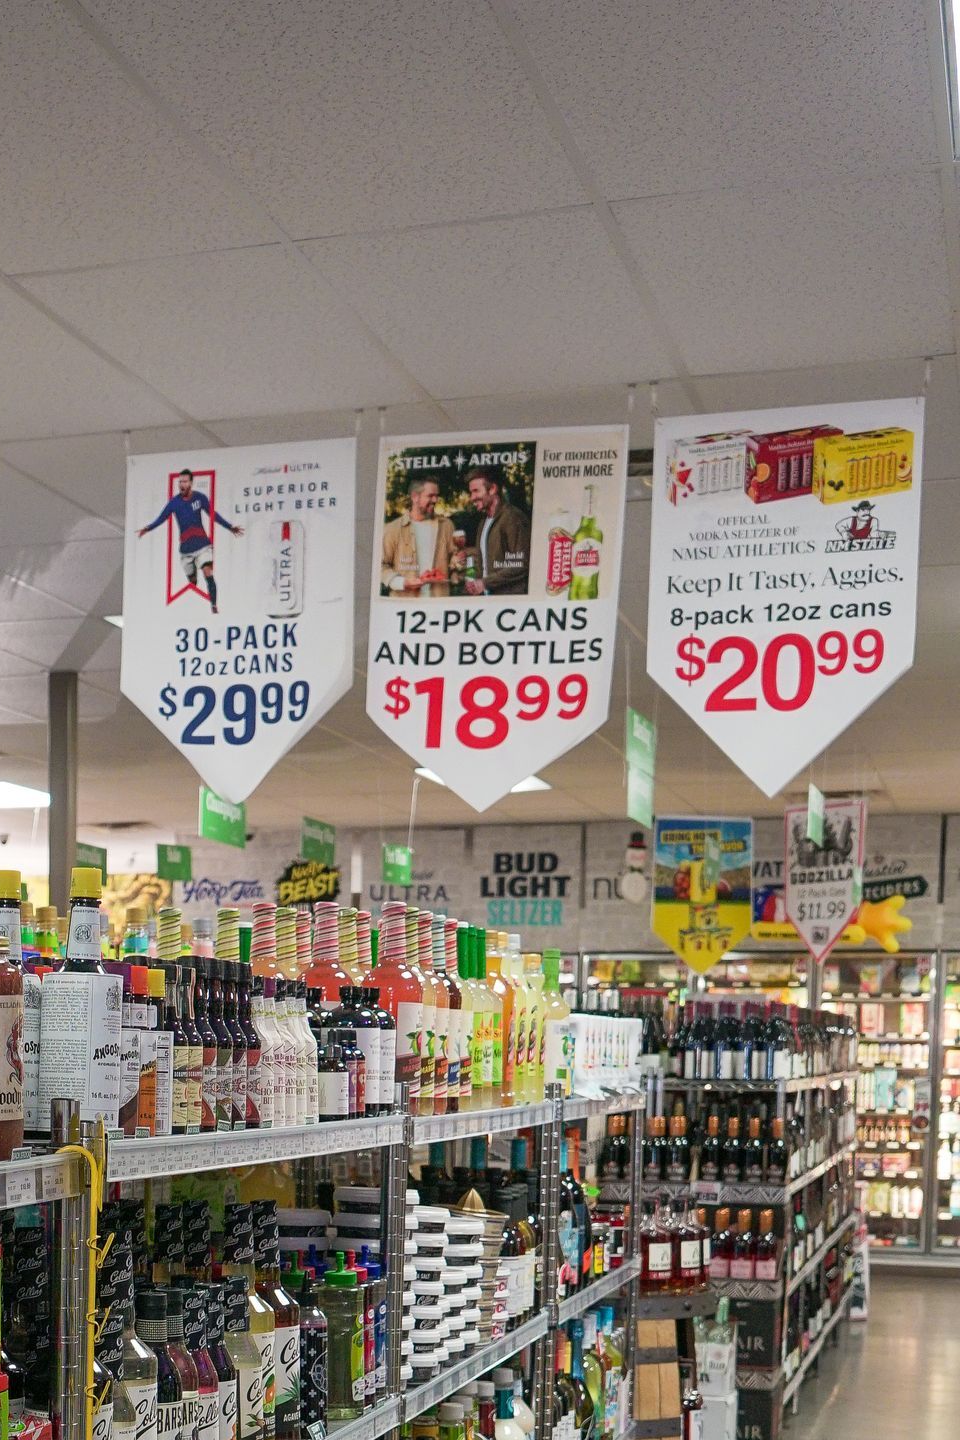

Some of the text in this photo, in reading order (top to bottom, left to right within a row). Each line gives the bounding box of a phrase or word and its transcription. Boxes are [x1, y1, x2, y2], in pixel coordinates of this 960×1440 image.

[395, 452, 528, 470] STELLA ARTOIS
[542, 448, 618, 462] For moments
[542, 464, 613, 478] WORTH MORE
[243, 481, 329, 497] SUPERIOR
[235, 497, 337, 514] LIGHT BEER
[717, 514, 770, 527] OFFICIAL
[689, 526, 799, 542] VODKA SELTZER OF
[672, 540, 816, 561] NMSU ATHLETICS
[551, 541, 561, 583] ARTOIS
[561, 541, 572, 583] STELLA
[280, 546, 292, 602] ULTRA
[667, 575, 721, 597] Keep
[728, 572, 743, 591] It
[821, 564, 904, 587] Aggies.
[396, 607, 588, 634] 12-PK CANS
[670, 600, 892, 630] 8-pack 12oz cans
[175, 622, 299, 653] 30-PACK
[375, 637, 603, 665] AND BOTTLES
[179, 653, 293, 676] 12oz CANS
[493, 853, 559, 874] BUD
[481, 876, 570, 898] LIGHT
[790, 868, 853, 885] GODZILLA
[279, 872, 339, 904] BEAST
[369, 884, 450, 902] ULTRA
[487, 900, 563, 926] SELTZER
[797, 901, 846, 922] $11.99
